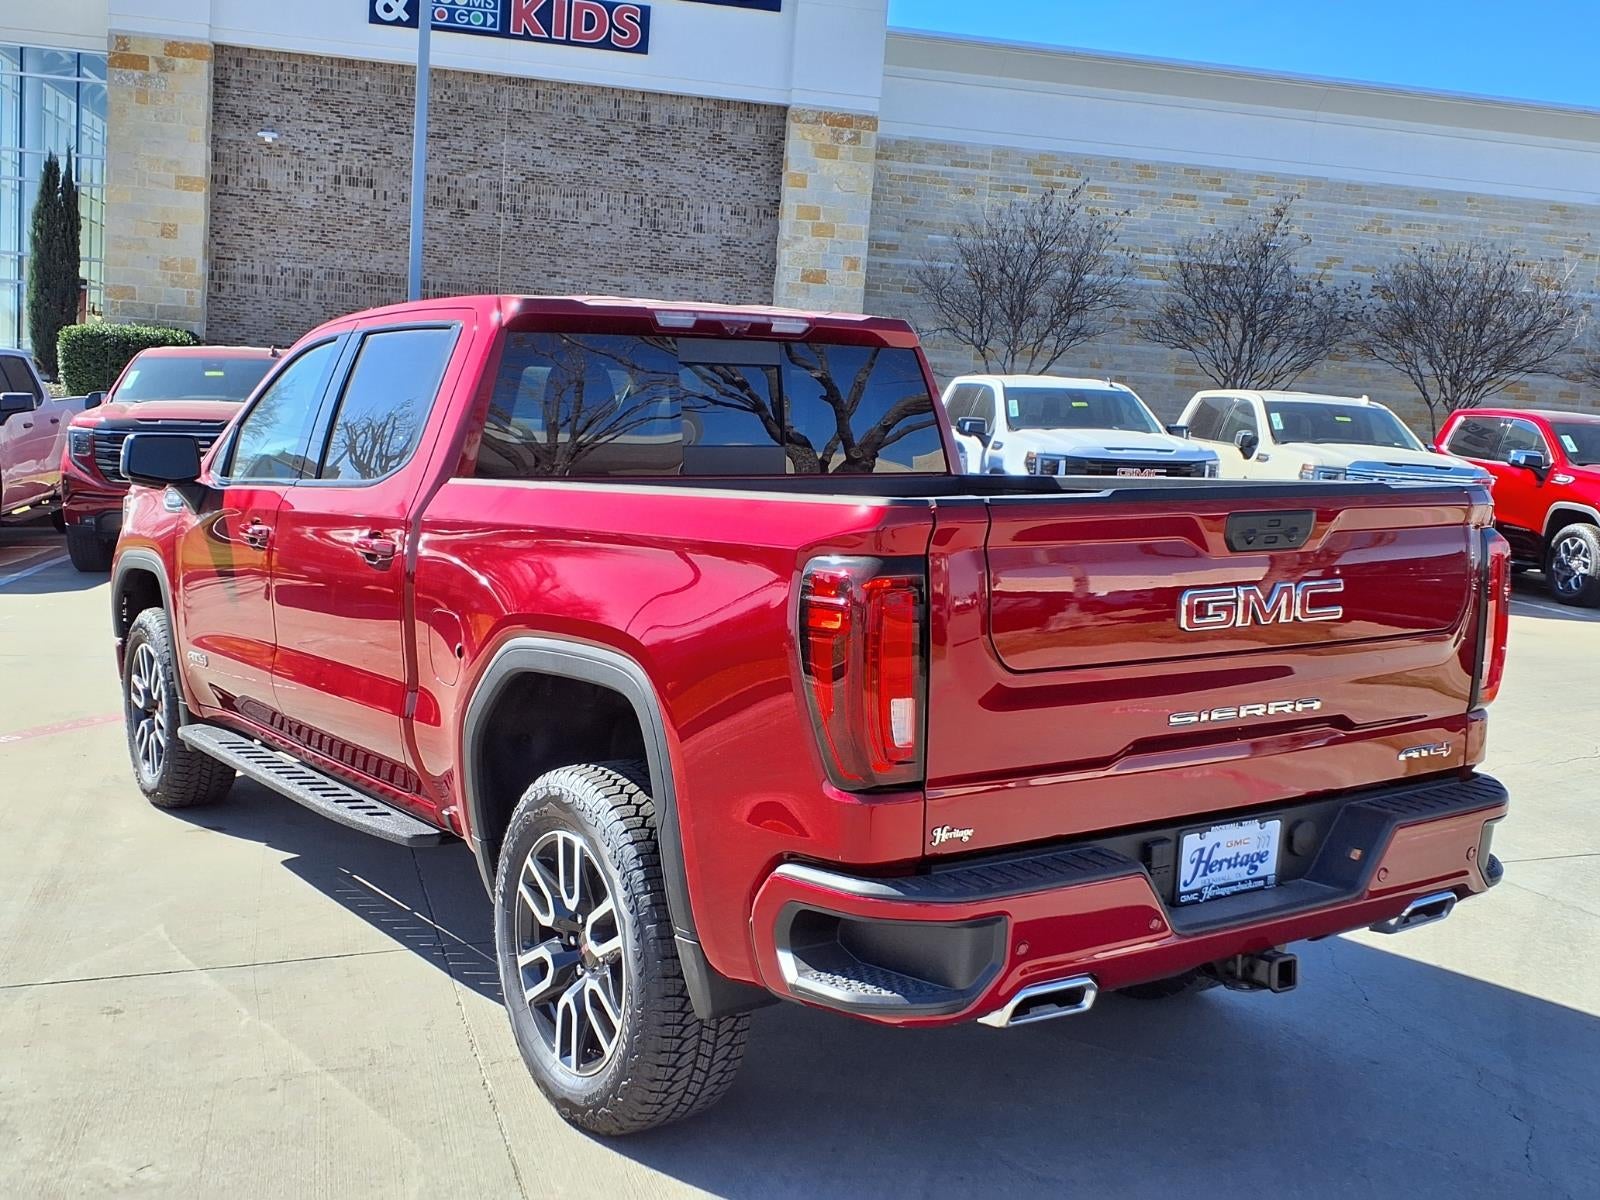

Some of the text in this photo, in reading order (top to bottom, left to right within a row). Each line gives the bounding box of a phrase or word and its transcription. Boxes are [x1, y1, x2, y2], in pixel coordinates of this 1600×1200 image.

[431, 6, 484, 26] O GO
[510, 0, 642, 48] KIDS
[1116, 467, 1167, 478] GMC
[1178, 578, 1344, 631] GMC
[1168, 697, 1322, 727] SIERRA
[1397, 741, 1452, 761] AT4
[930, 824, 974, 847] Heritage
[1226, 837, 1251, 848] GMC
[1183, 841, 1270, 888] Heritage
[1180, 892, 1199, 903] GMC
